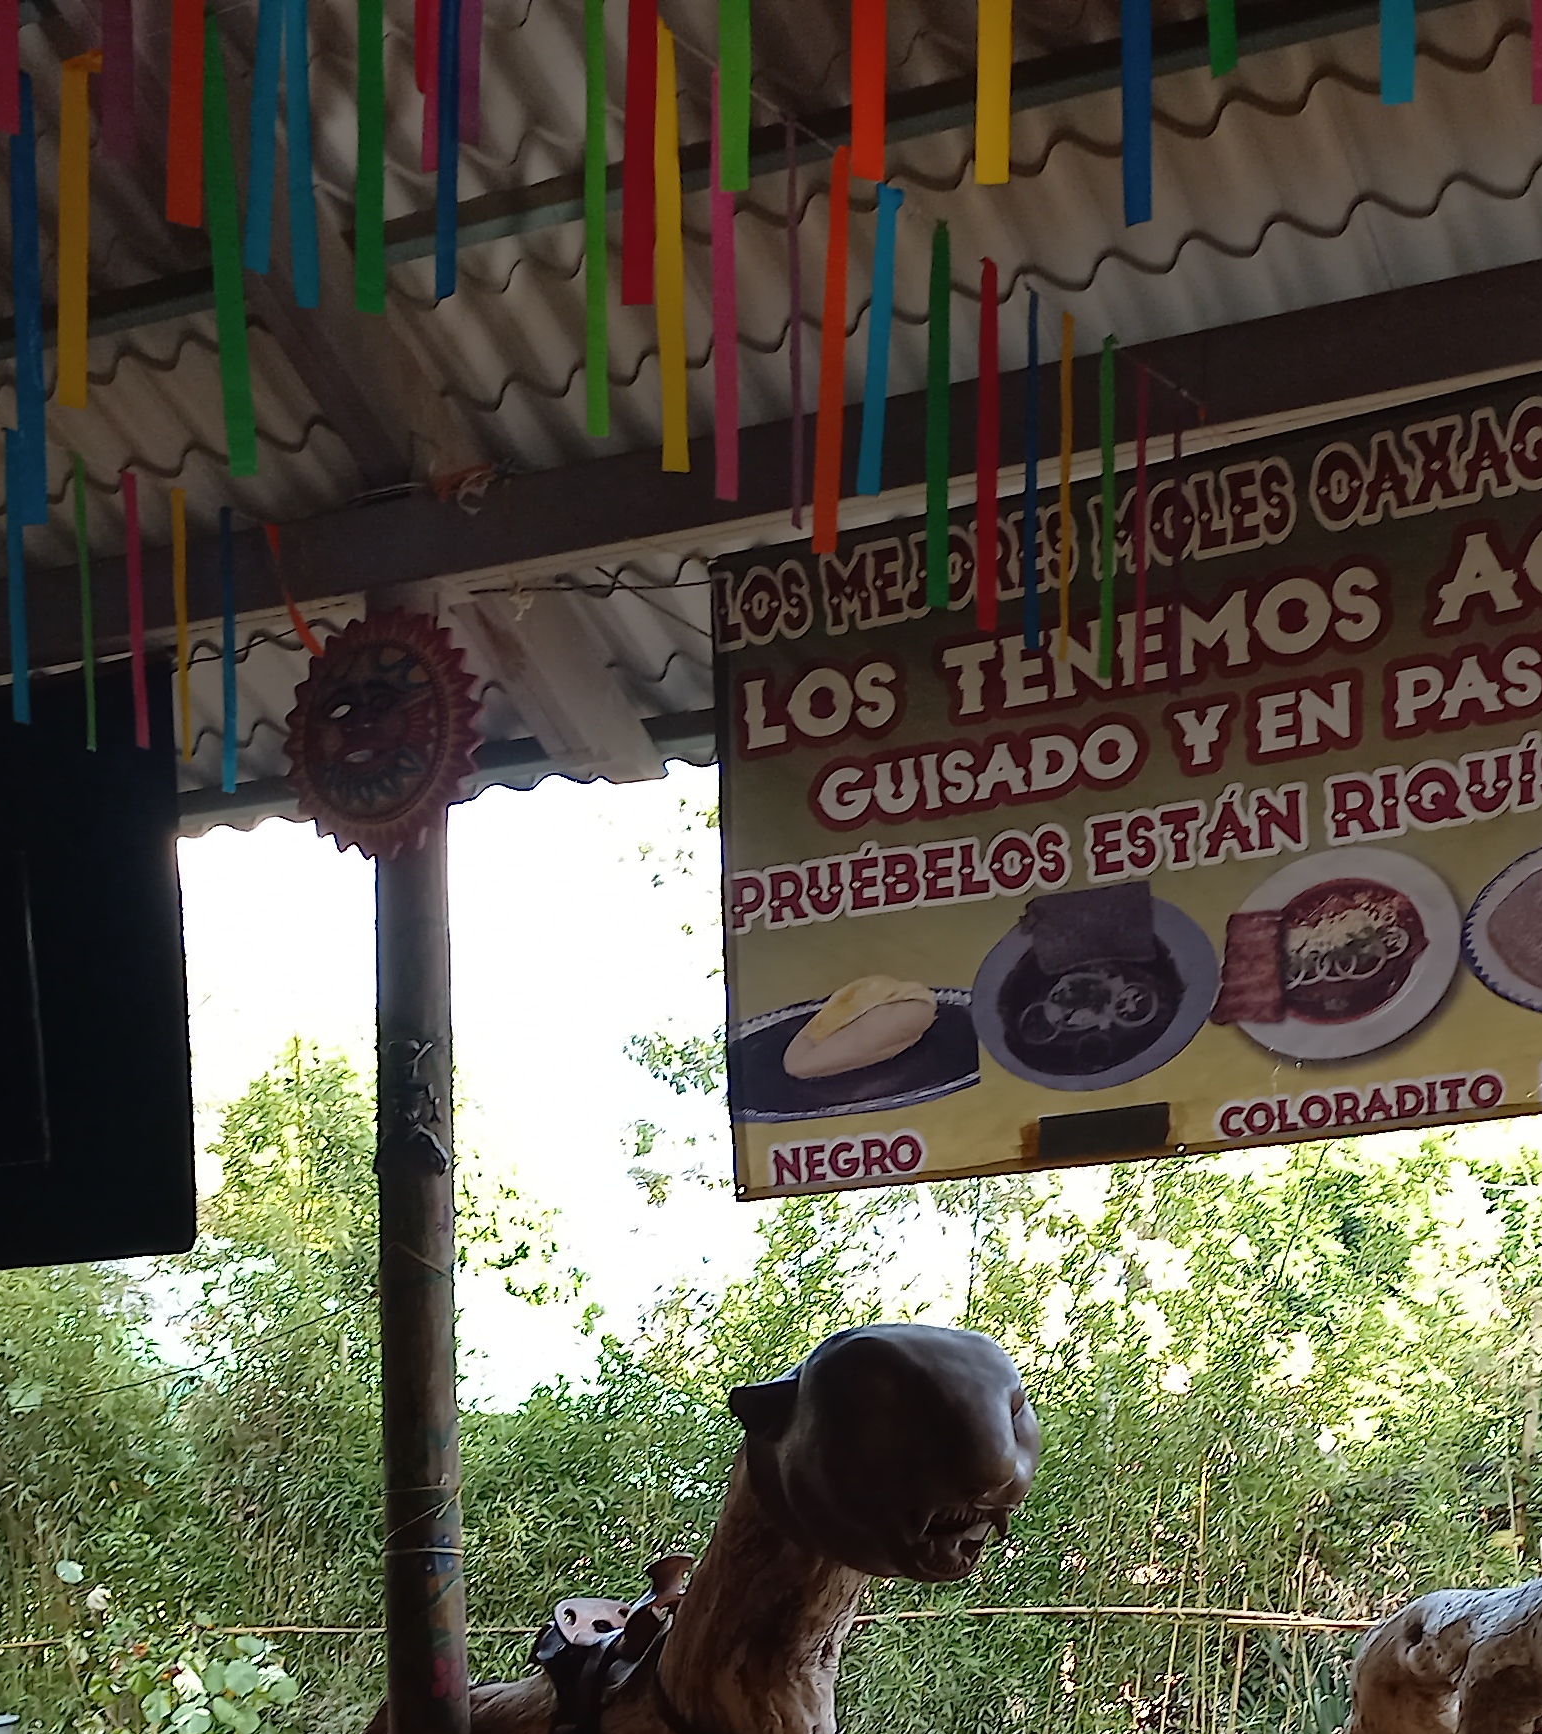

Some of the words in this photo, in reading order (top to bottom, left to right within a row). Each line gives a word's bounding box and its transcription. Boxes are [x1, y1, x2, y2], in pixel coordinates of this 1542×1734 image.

[715, 560, 812, 650] LOS
[1089, 459, 1295, 579] MOLES
[742, 661, 898, 750] LOS
[943, 567, 1382, 716] TENEMOS
[817, 723, 1138, 822] GUISADO
[1173, 703, 1230, 766] Y
[1257, 681, 1352, 755] EN
[730, 828, 1066, 930] PRUÉBELOS
[1089, 788, 1302, 877] ESTÁN
[772, 1134, 923, 1187] NEGRO
[1219, 1074, 1503, 1139] COLORADITO
